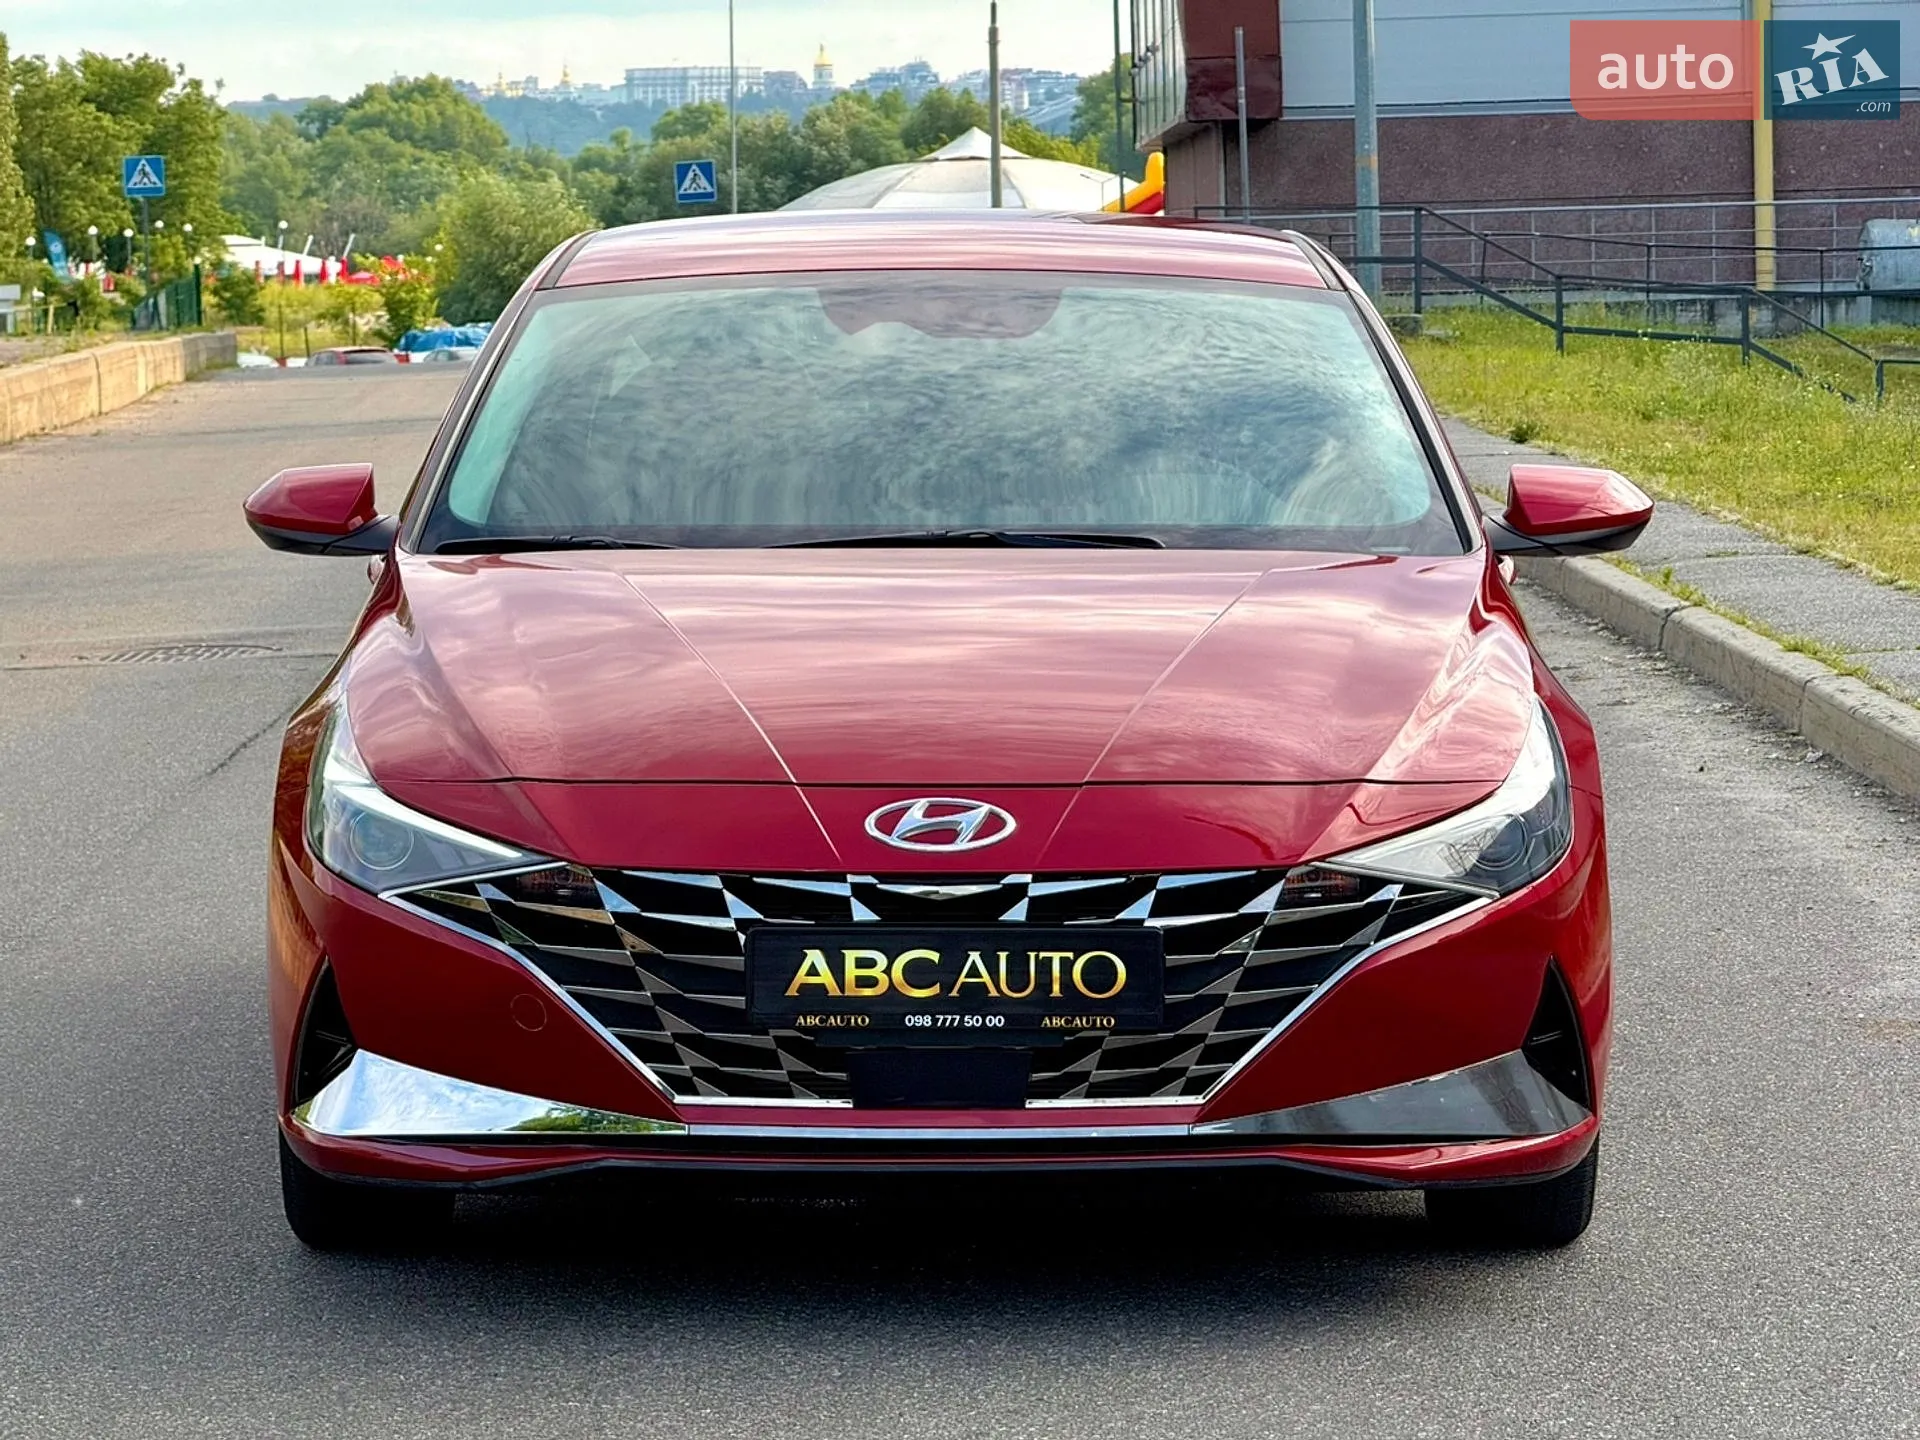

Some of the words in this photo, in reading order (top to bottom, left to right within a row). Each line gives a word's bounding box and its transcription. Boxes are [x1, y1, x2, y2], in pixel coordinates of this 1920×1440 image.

[784, 948, 941, 997] ABC
[948, 950, 1127, 998] AUTO
[795, 1015, 870, 1027] ABCAUTO
[905, 1014, 932, 1028] 098
[936, 1014, 960, 1028] 777
[964, 1014, 983, 1028] 50
[986, 1014, 1005, 1028] 00
[1041, 1016, 1115, 1028] ABCAUTO
